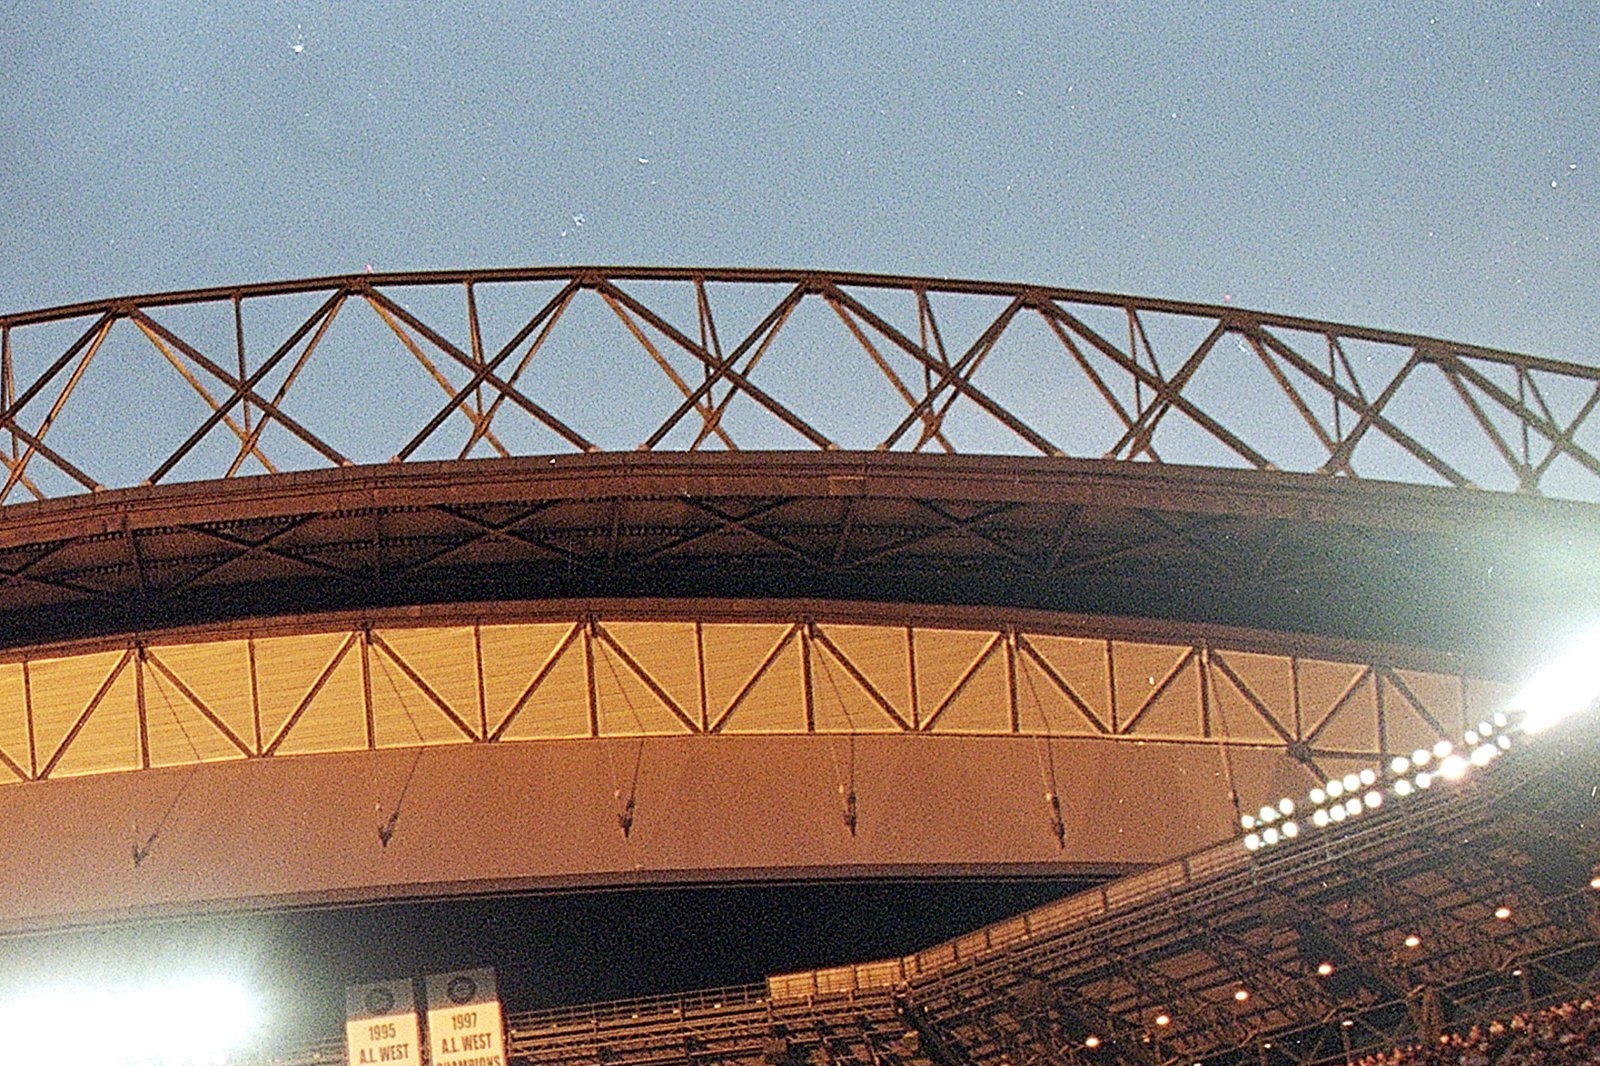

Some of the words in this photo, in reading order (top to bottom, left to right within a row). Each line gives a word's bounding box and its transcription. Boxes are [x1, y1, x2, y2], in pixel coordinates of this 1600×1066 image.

[452, 1012, 477, 1030] 1997
[368, 1023, 397, 1041] 1995
[461, 1033, 491, 1051] WEST
[380, 1044, 408, 1062] WEST
